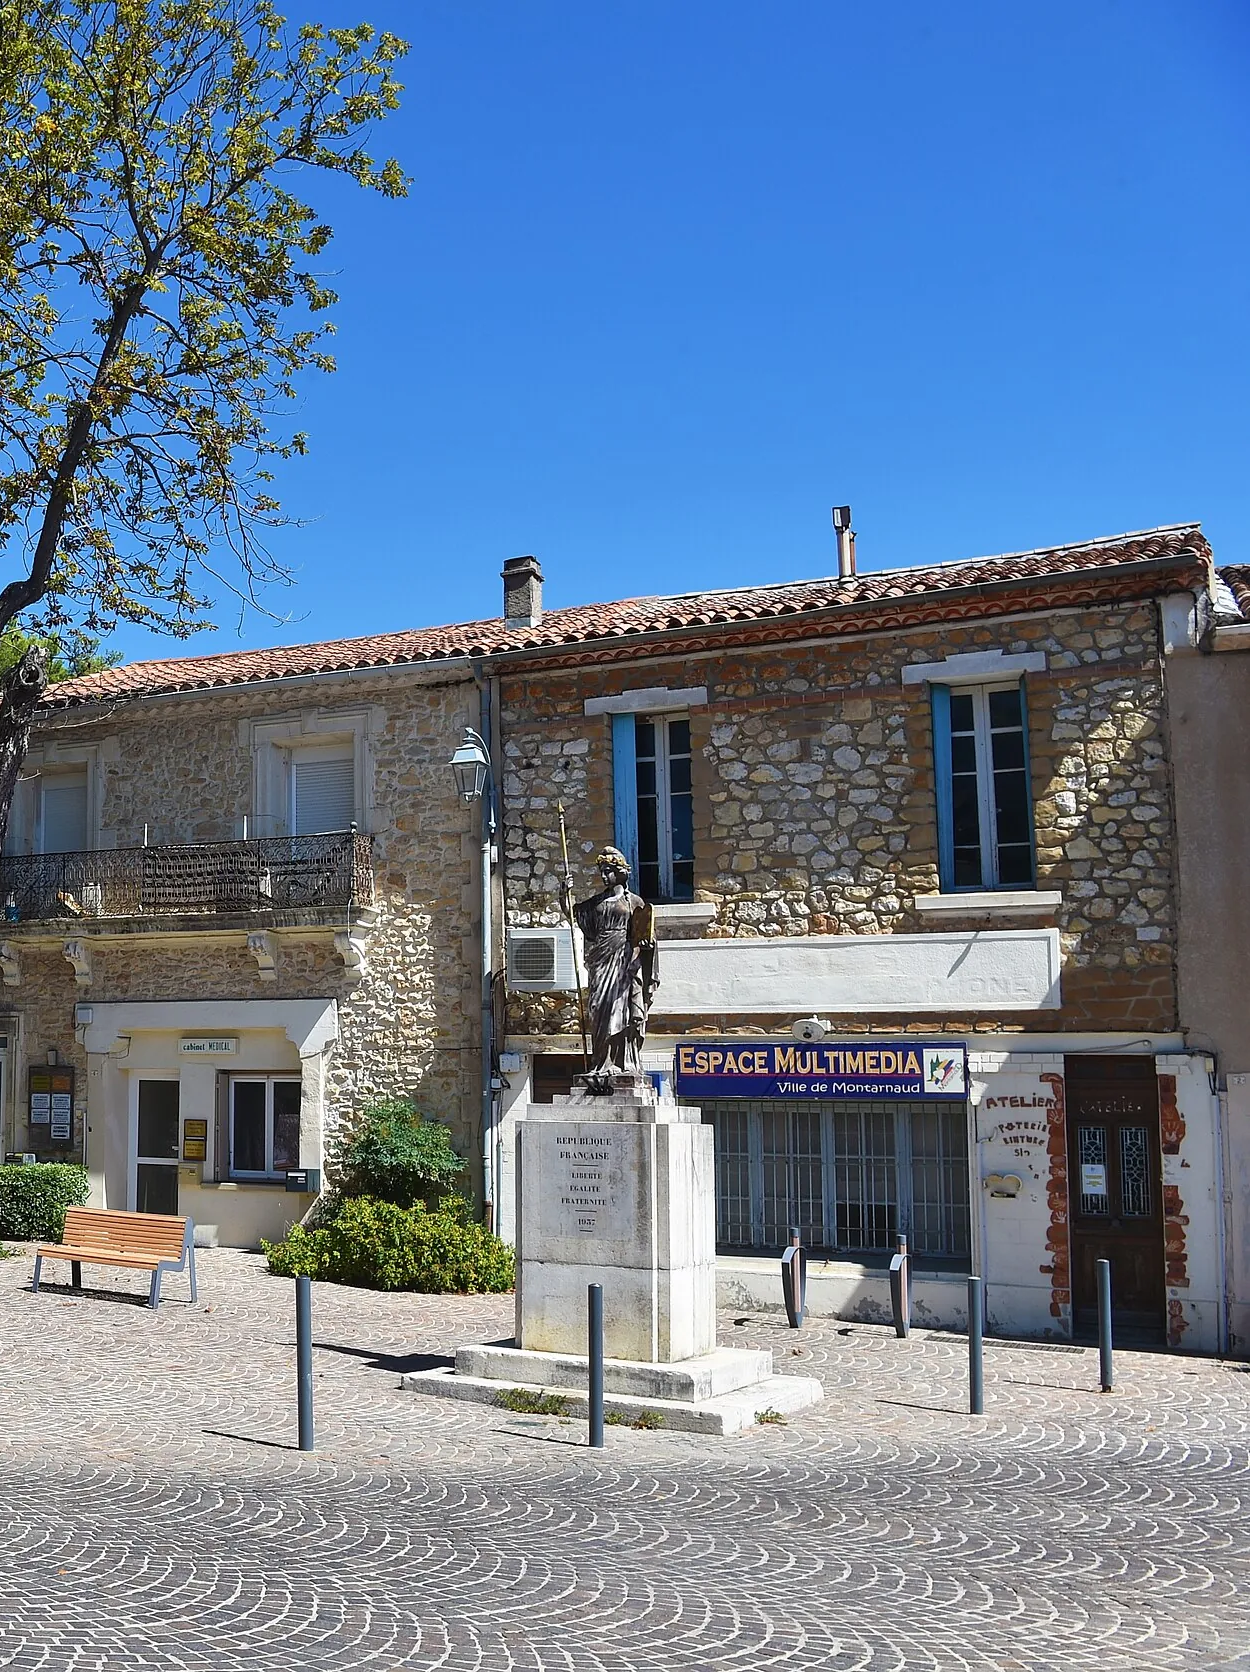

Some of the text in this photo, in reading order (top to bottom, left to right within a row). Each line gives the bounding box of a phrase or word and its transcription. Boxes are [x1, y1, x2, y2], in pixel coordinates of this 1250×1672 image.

[182, 1041, 231, 1051] cabinet MEDICAL
[679, 1047, 921, 1075] ESPACE MULTIMEDIA
[777, 1082, 920, 1094] Ville de Montarnaud
[559, 1151, 610, 1161] FRANÇAISE
